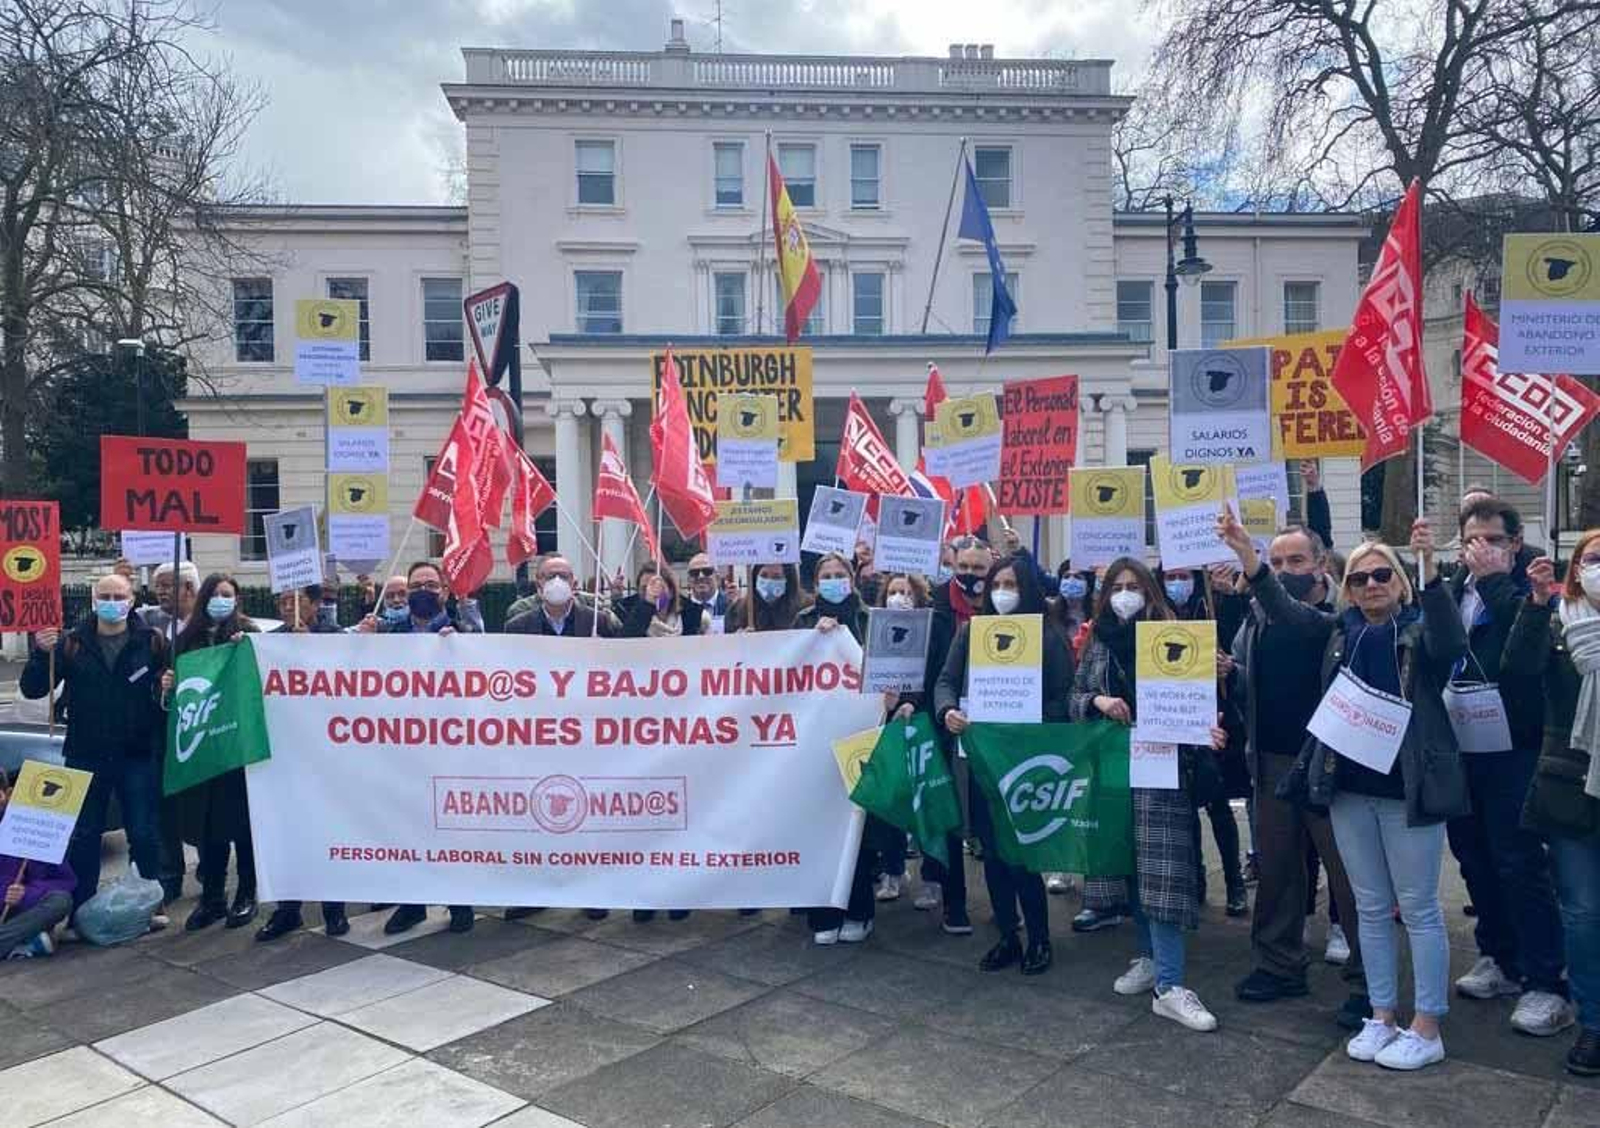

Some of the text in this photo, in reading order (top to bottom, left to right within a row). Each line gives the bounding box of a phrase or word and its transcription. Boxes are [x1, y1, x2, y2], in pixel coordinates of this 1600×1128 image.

[474, 298, 501, 322] GIVE
[1511, 314, 1582, 325] MINISTERIO
[1516, 330, 1596, 341] ABANDONO
[1523, 345, 1586, 357] EXTERIOR
[653, 352, 797, 388] EDINBURGH
[1285, 379, 1328, 410] IS
[1475, 390, 1544, 436] federación
[1192, 428, 1249, 441] SALARIOS
[1484, 411, 1551, 456] ciudadanía
[136, 447, 215, 477] TODO
[1001, 449, 1018, 477] el
[1184, 446, 1256, 459] DIGNOS YA
[125, 488, 220, 525] MAL
[999, 477, 1066, 510] EXISTE
[17, 600, 60, 627] 2008
[264, 662, 861, 702] ABANDONAD@S Y BAJO MÍNIMOS
[974, 676, 1036, 686] MINISTERIO DE
[978, 688, 1031, 698] ABANDONO
[327, 713, 797, 747] CONDICIONES DIGNAS YA
[1143, 717, 1183, 727] WITHOUT
[1008, 778, 1089, 813] CSIF
[329, 846, 801, 867] PERSONAL LABORAL SIN CONVENIO EN EL EXTERIOR
